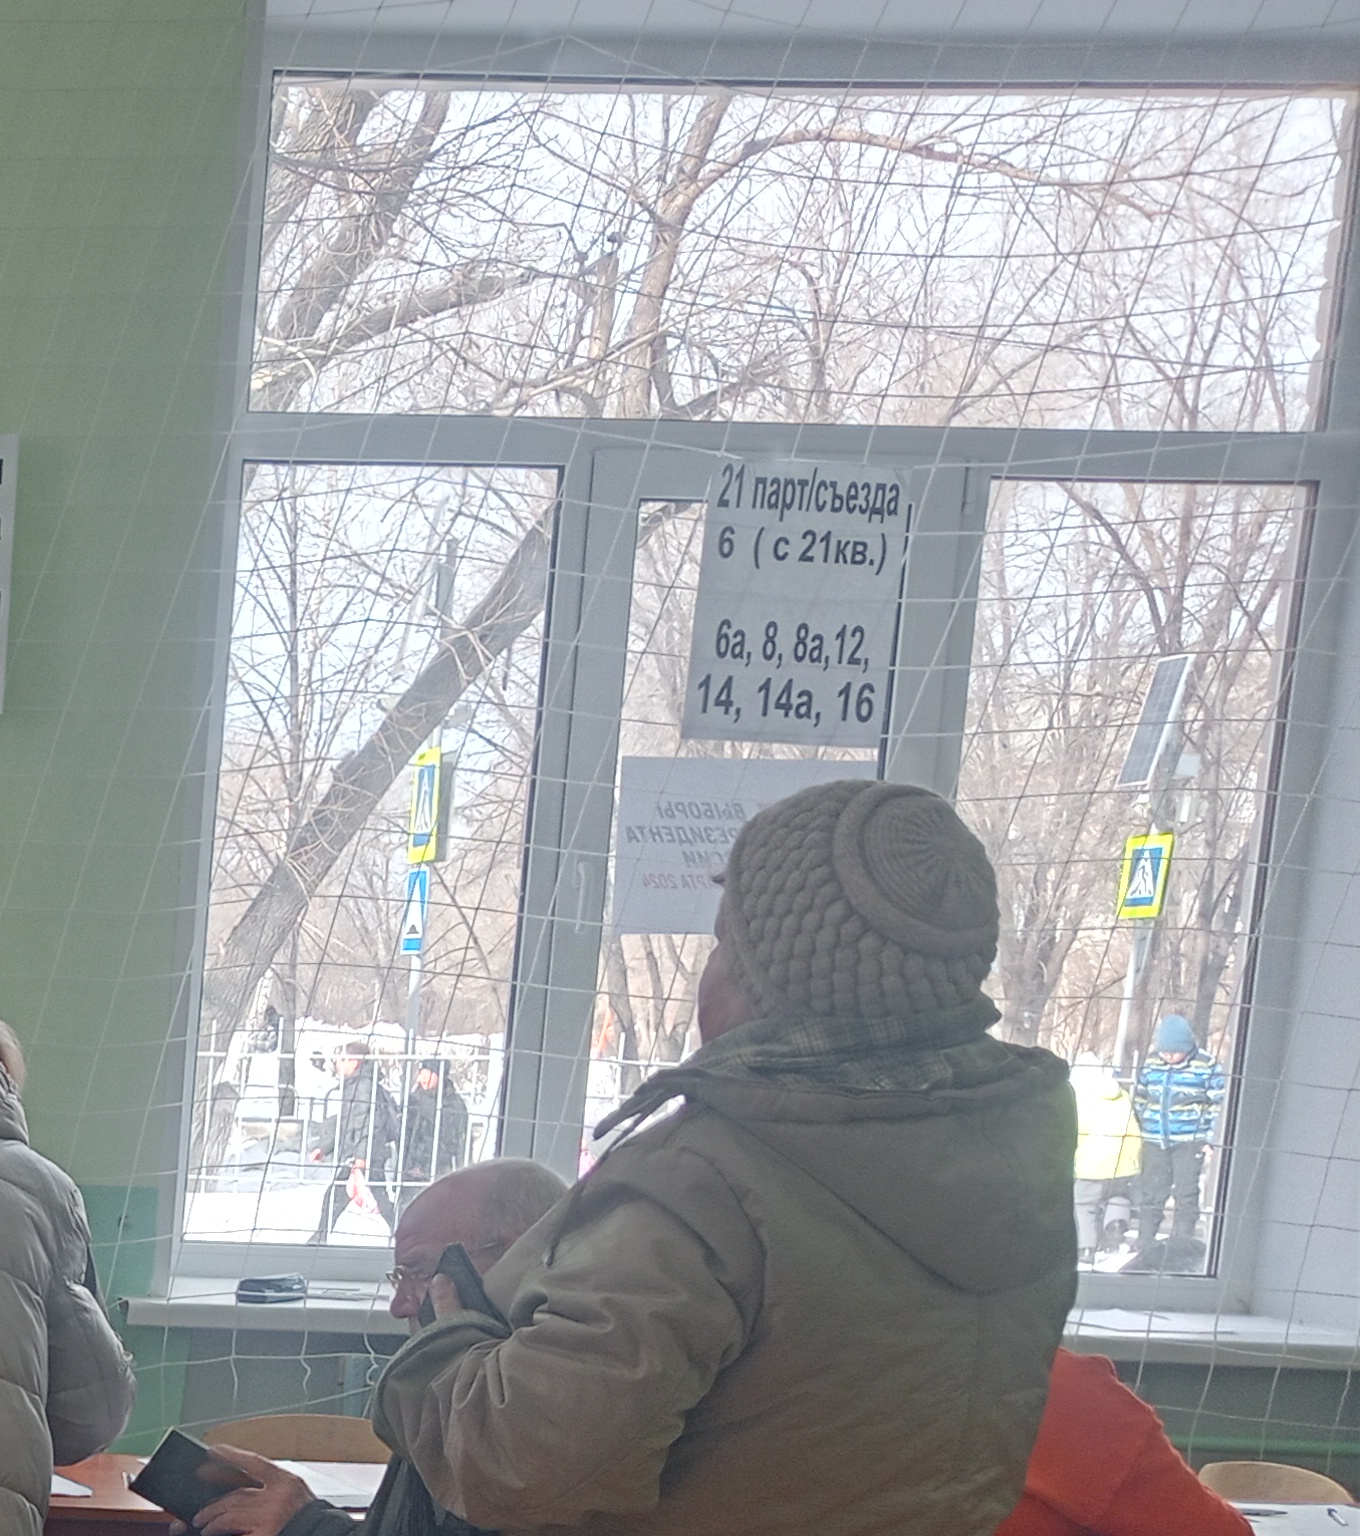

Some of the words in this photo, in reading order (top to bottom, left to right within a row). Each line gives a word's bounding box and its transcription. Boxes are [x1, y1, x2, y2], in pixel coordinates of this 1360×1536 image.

[717, 463, 745, 508] 21
[752, 467, 900, 524] парт/съезда
[718, 526, 735, 559] 6
[798, 529, 887, 576] 21кв.)
[716, 619, 751, 667] 6а,
[762, 621, 783, 669] 8,
[698, 674, 741, 724] 14,
[757, 677, 821, 728] 14а,
[838, 681, 875, 723] 16
